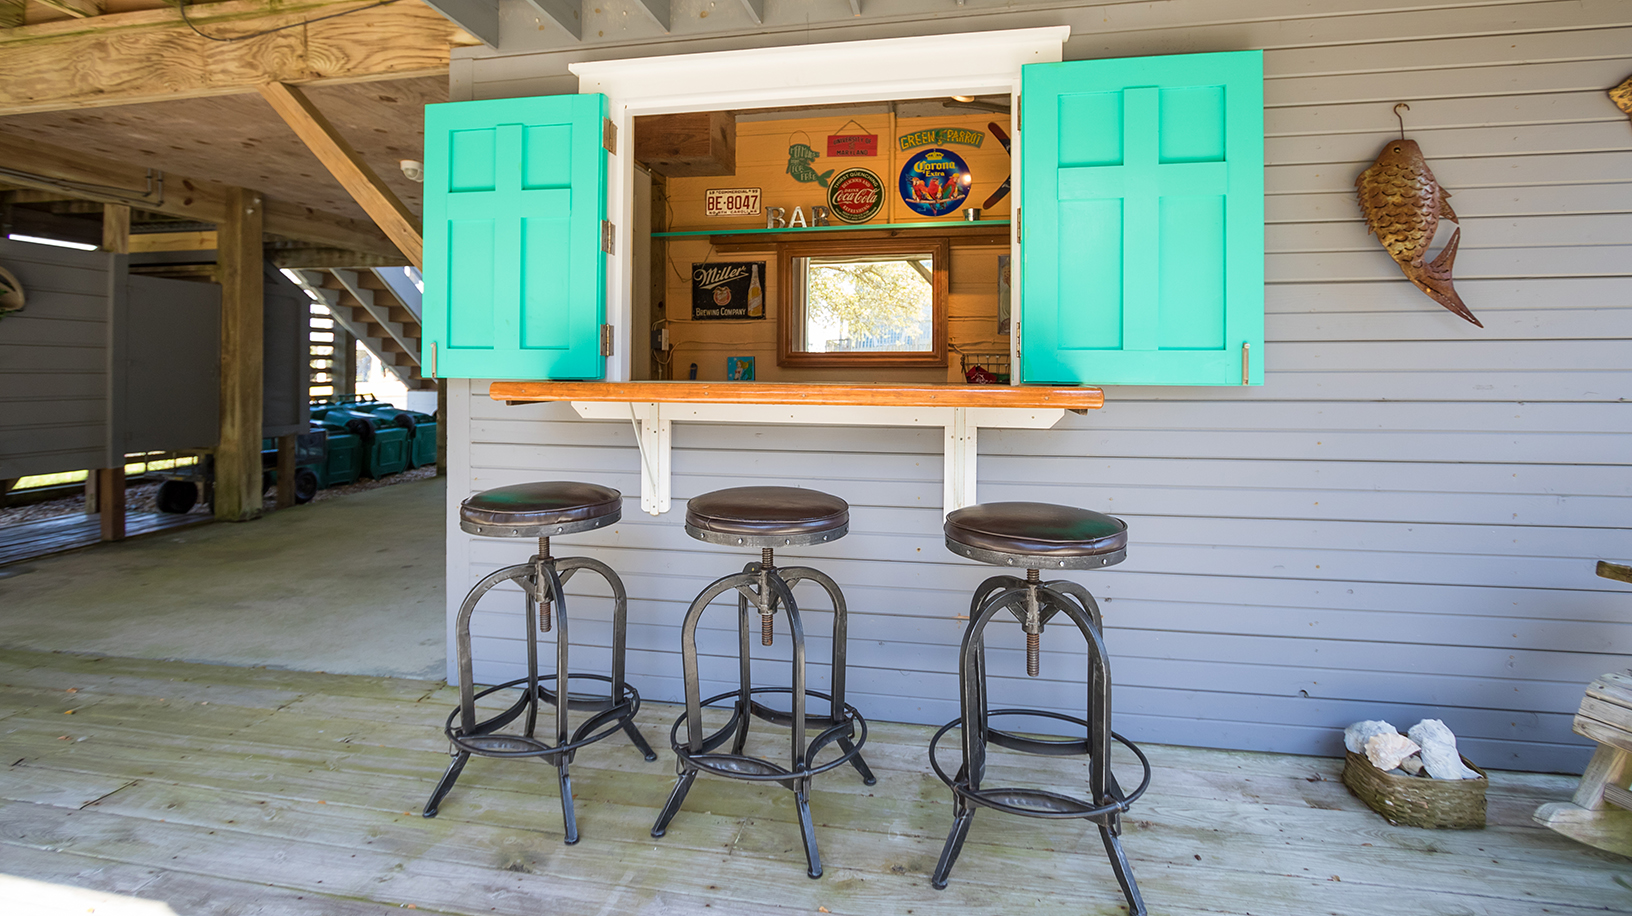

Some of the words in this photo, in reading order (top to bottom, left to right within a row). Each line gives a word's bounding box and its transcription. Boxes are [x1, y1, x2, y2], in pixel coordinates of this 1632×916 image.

[901, 131, 935, 150] GREEN
[947, 130, 983, 145] PARROT
[914, 161, 955, 173] Corona
[834, 174, 850, 189] THIRST
[850, 171, 879, 187] QUENCHING
[832, 188, 880, 205] Coca-Cola
[765, 205, 830, 229] BAR
[694, 266, 746, 287] Miller
[695, 307, 720, 316] BREWING
[720, 307, 746, 316] COMPANY
